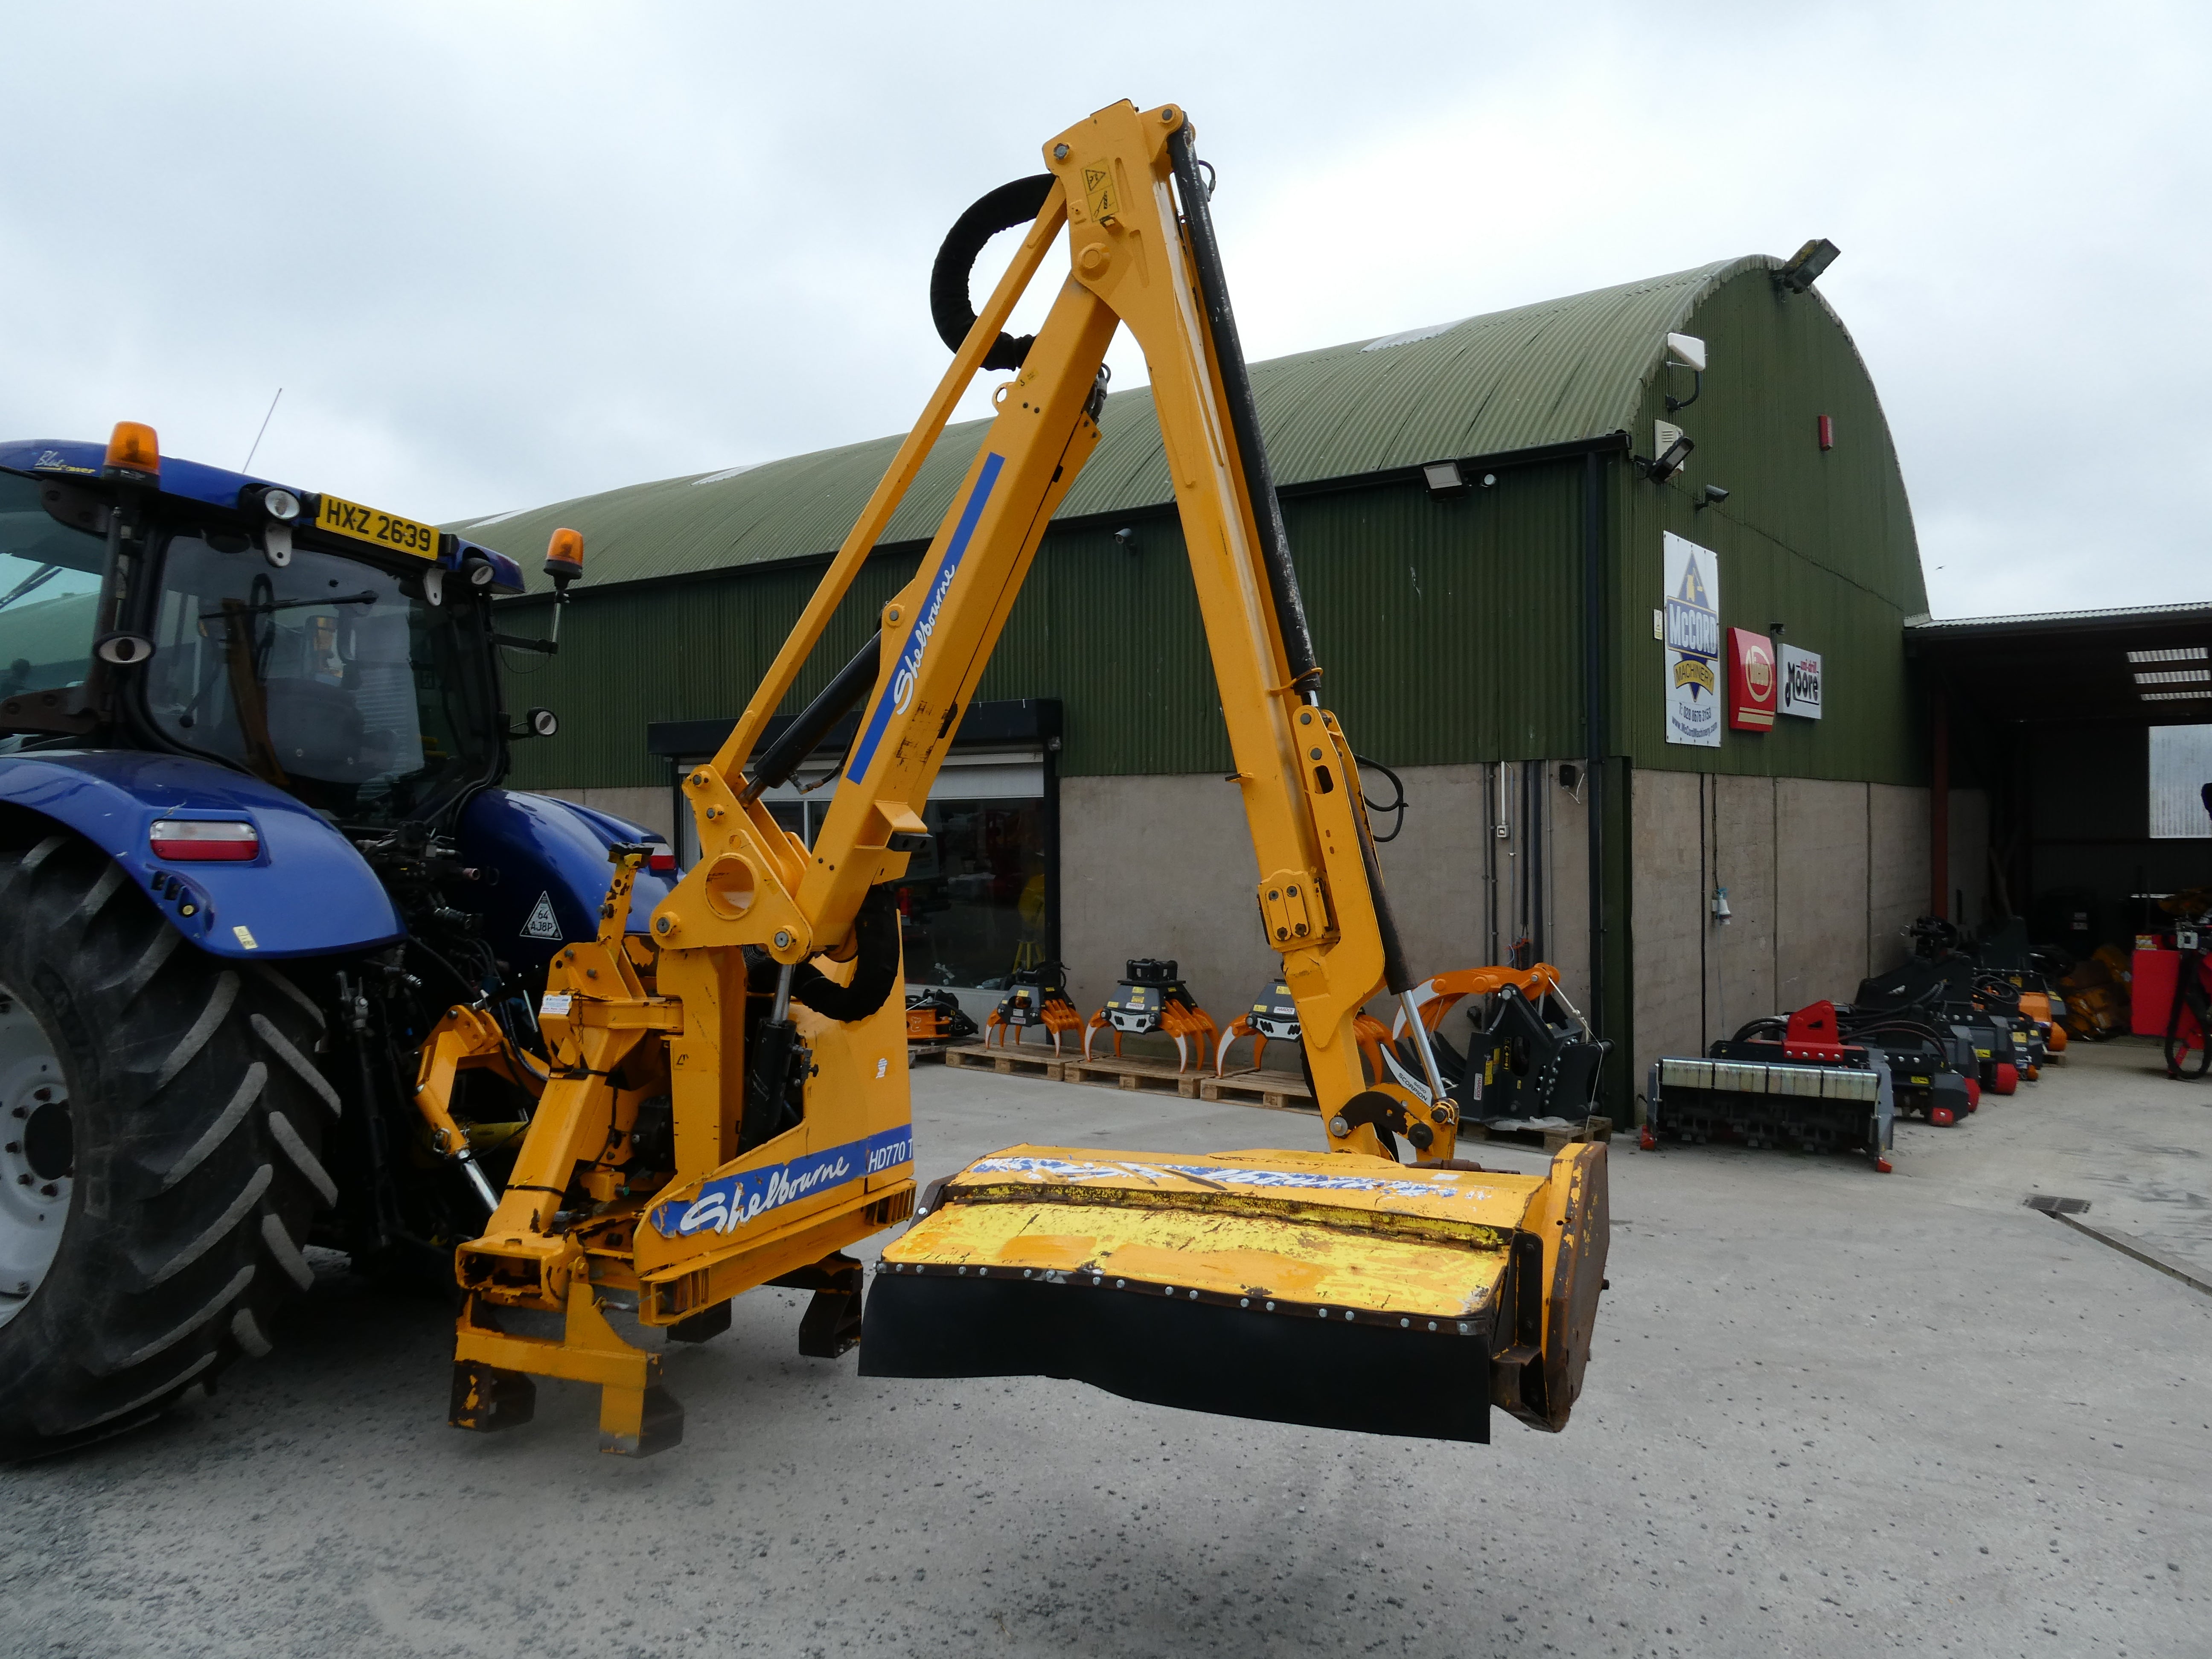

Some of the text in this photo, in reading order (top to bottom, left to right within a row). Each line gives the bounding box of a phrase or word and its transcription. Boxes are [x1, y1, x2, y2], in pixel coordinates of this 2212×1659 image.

[326, 499, 431, 552] HXZ 2639
[894, 565, 955, 715] Shelbourne
[1676, 663, 1713, 688] MACHINERY
[1785, 661, 1818, 707] Moore
[1679, 702, 1682, 716] T:
[531, 921, 553, 932] AJ8P
[538, 910, 548, 920] 64
[1398, 1073, 1428, 1101] SCORPION
[680, 1156, 850, 1234] Shelbourne
[868, 1141, 906, 1173] HD770
